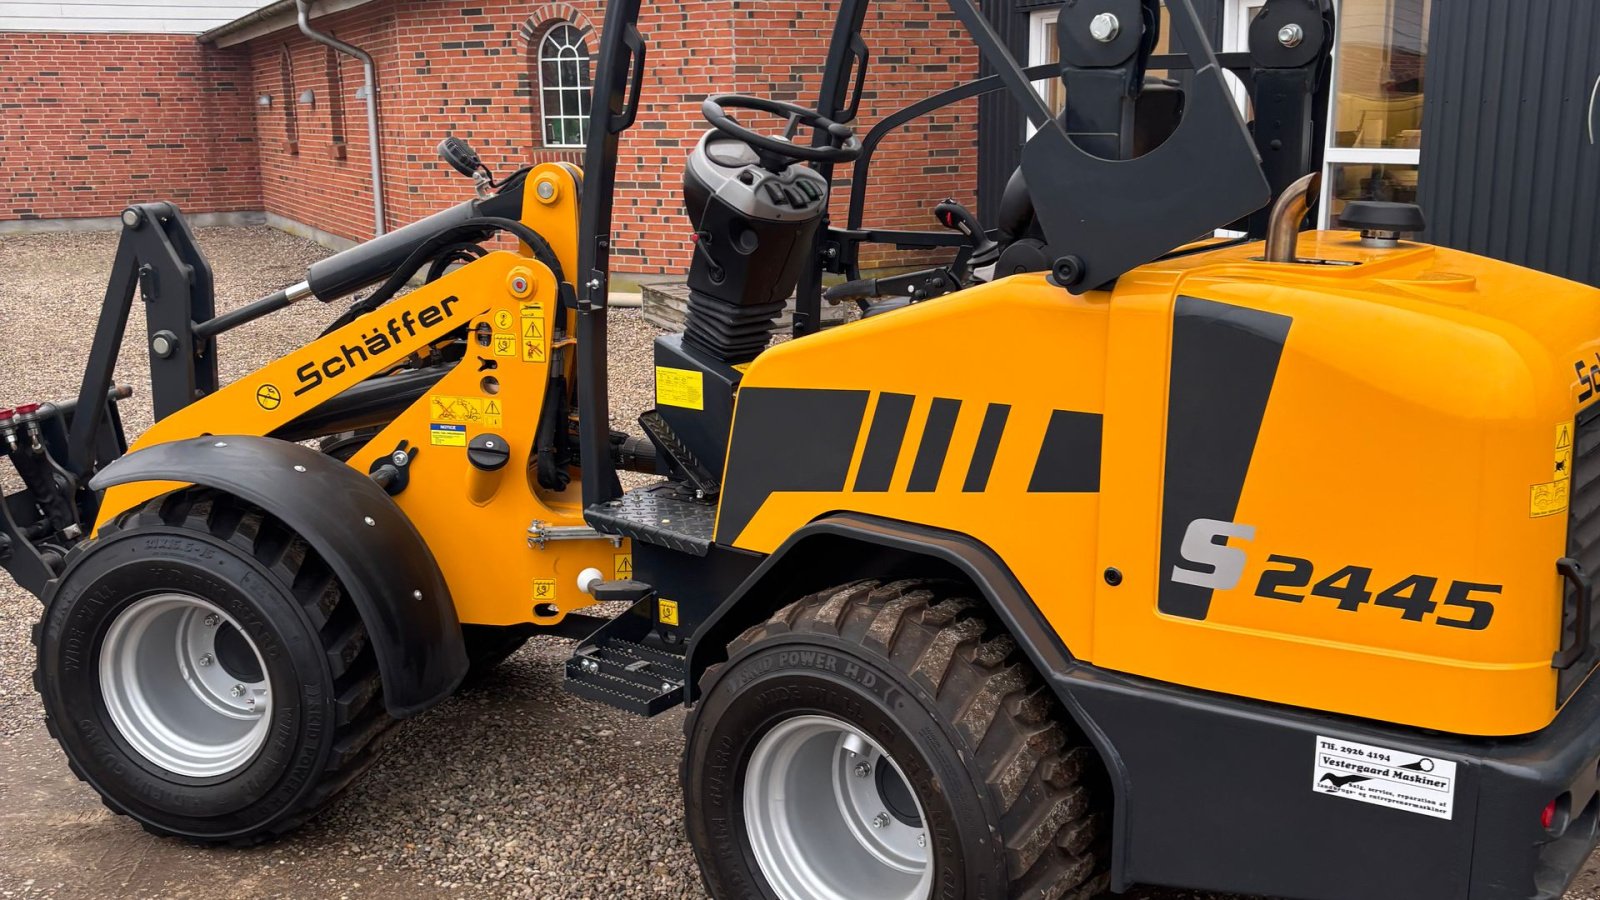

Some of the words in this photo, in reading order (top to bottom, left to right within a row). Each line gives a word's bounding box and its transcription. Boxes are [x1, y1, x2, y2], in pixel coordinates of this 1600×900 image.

[293, 295, 460, 398] Schäffer
[1171, 518, 1256, 591] S
[1254, 553, 1503, 631] 2445
[779, 650, 837, 671] POWER
[1320, 741, 1338, 751] Tlf.
[1340, 746, 1364, 756] 2926
[1366, 752, 1391, 762] 4194
[1323, 756, 1389, 777] Vestergaard
[1392, 770, 1447, 788] Maskiner
[1397, 793, 1436, 805] reparation
